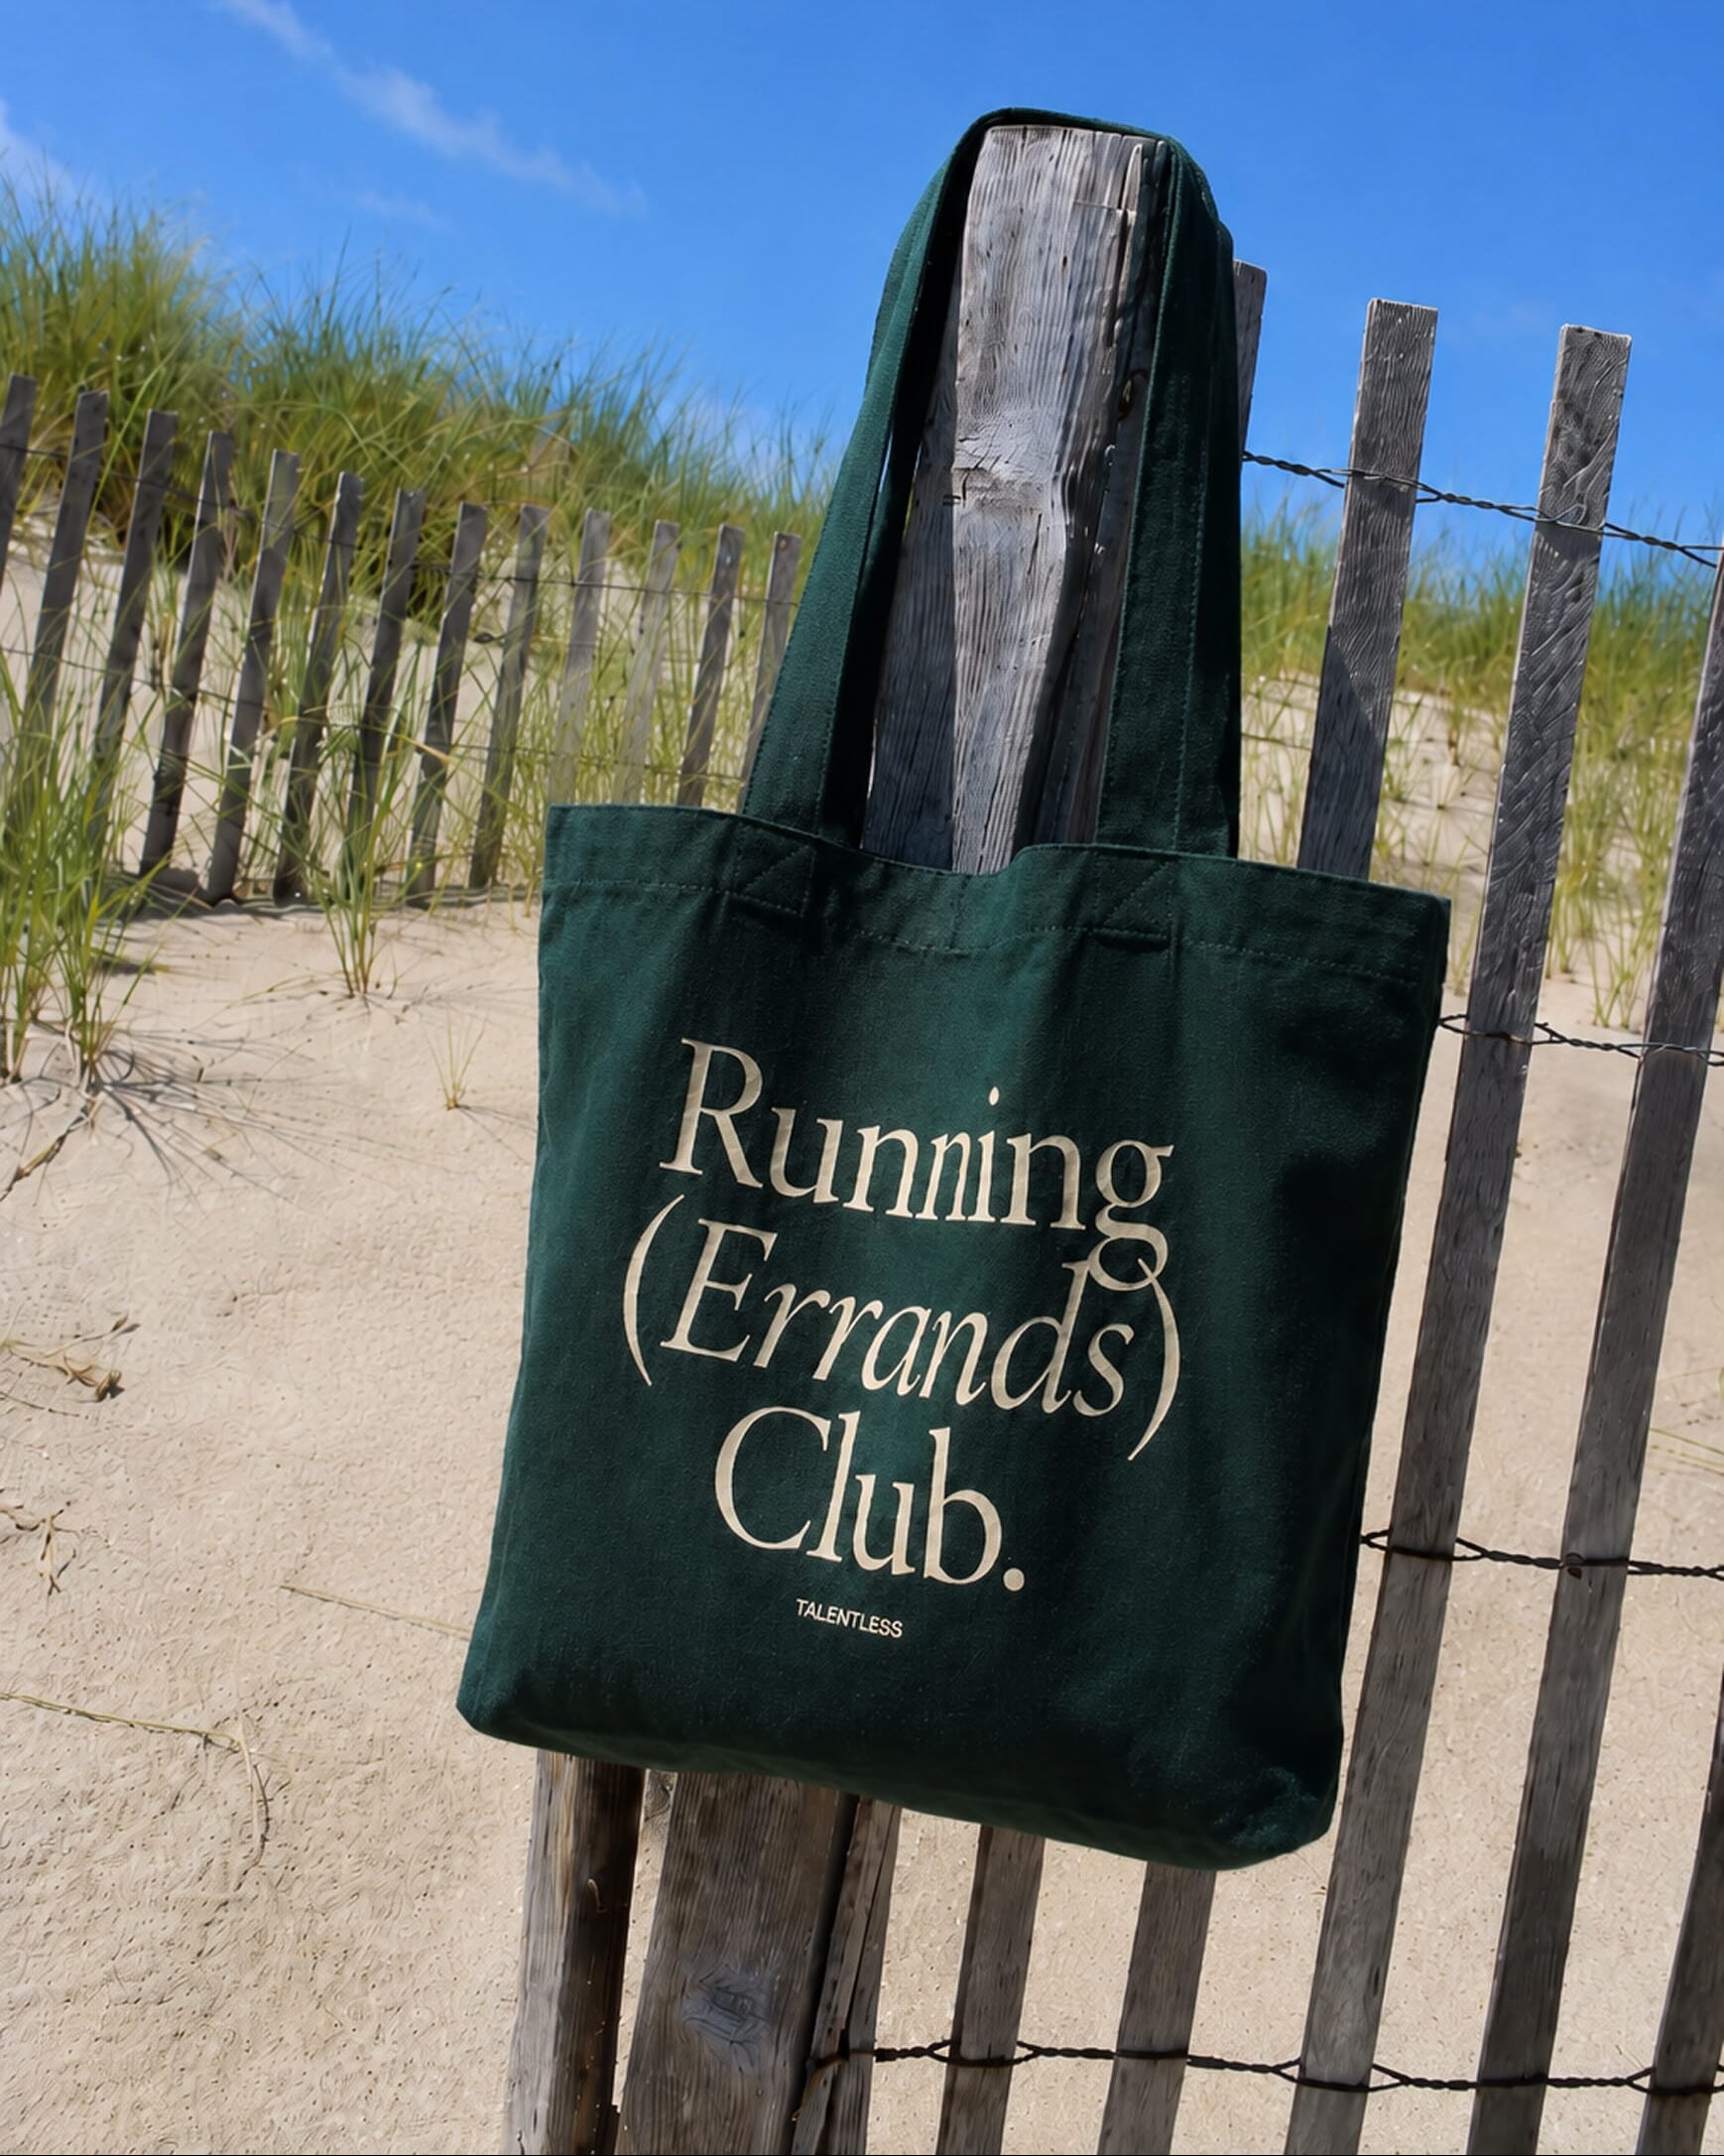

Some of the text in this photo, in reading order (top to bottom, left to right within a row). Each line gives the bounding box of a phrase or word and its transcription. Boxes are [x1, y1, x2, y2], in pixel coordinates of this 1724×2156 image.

[659, 1038, 1174, 1292] Running
[623, 1194, 1180, 1461] (Errands)
[714, 1406, 1025, 1591] Club.
[796, 1598, 904, 1638] TALENTLESS
